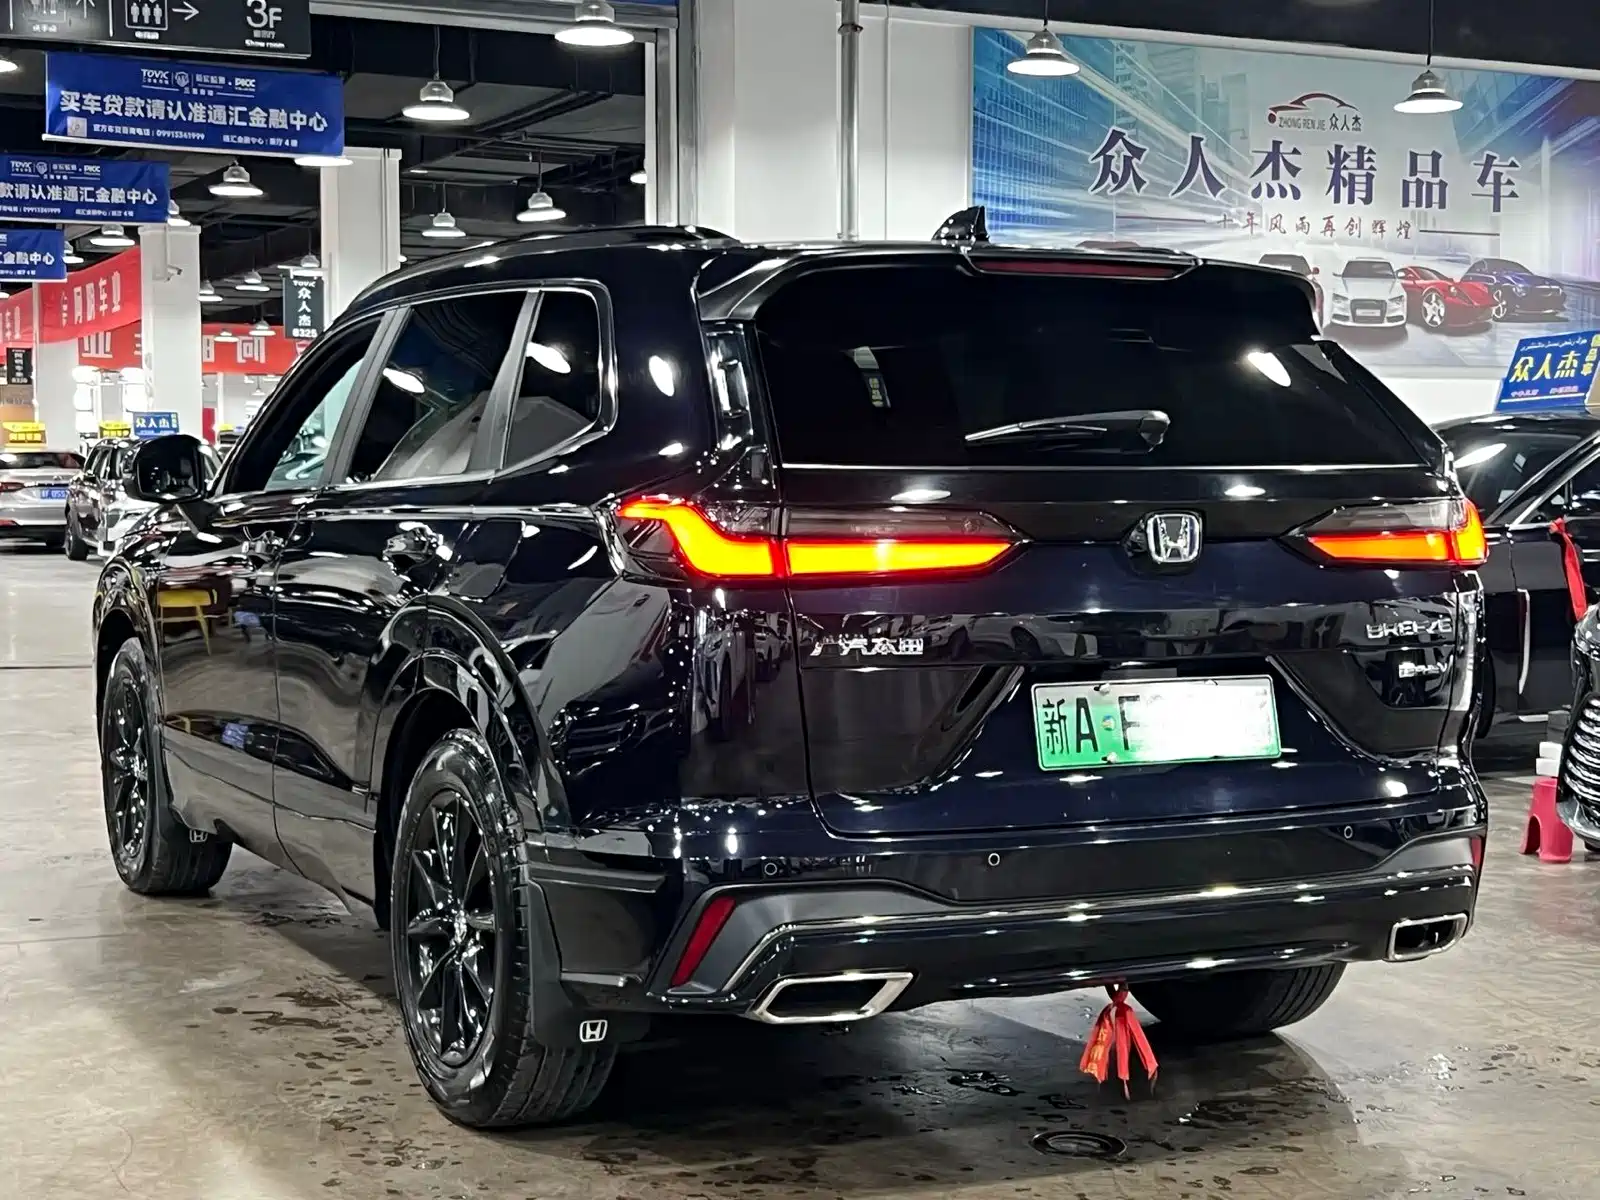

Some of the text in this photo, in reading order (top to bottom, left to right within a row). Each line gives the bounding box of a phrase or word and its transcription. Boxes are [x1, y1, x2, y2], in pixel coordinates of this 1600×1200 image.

[246, 0, 283, 28] 3F
[60, 90, 328, 132] 买车贷款请认准通汇金融中心
[1329, 113, 1362, 132] 众人杰
[1090, 127, 1519, 212] 众人杰精品车
[1216, 211, 1412, 240] 十年风雨再创辉煌
[0, 251, 55, 266] 金融中心
[1508, 350, 1581, 382] 众人杰
[809, 633, 924, 656] 广汽本田
